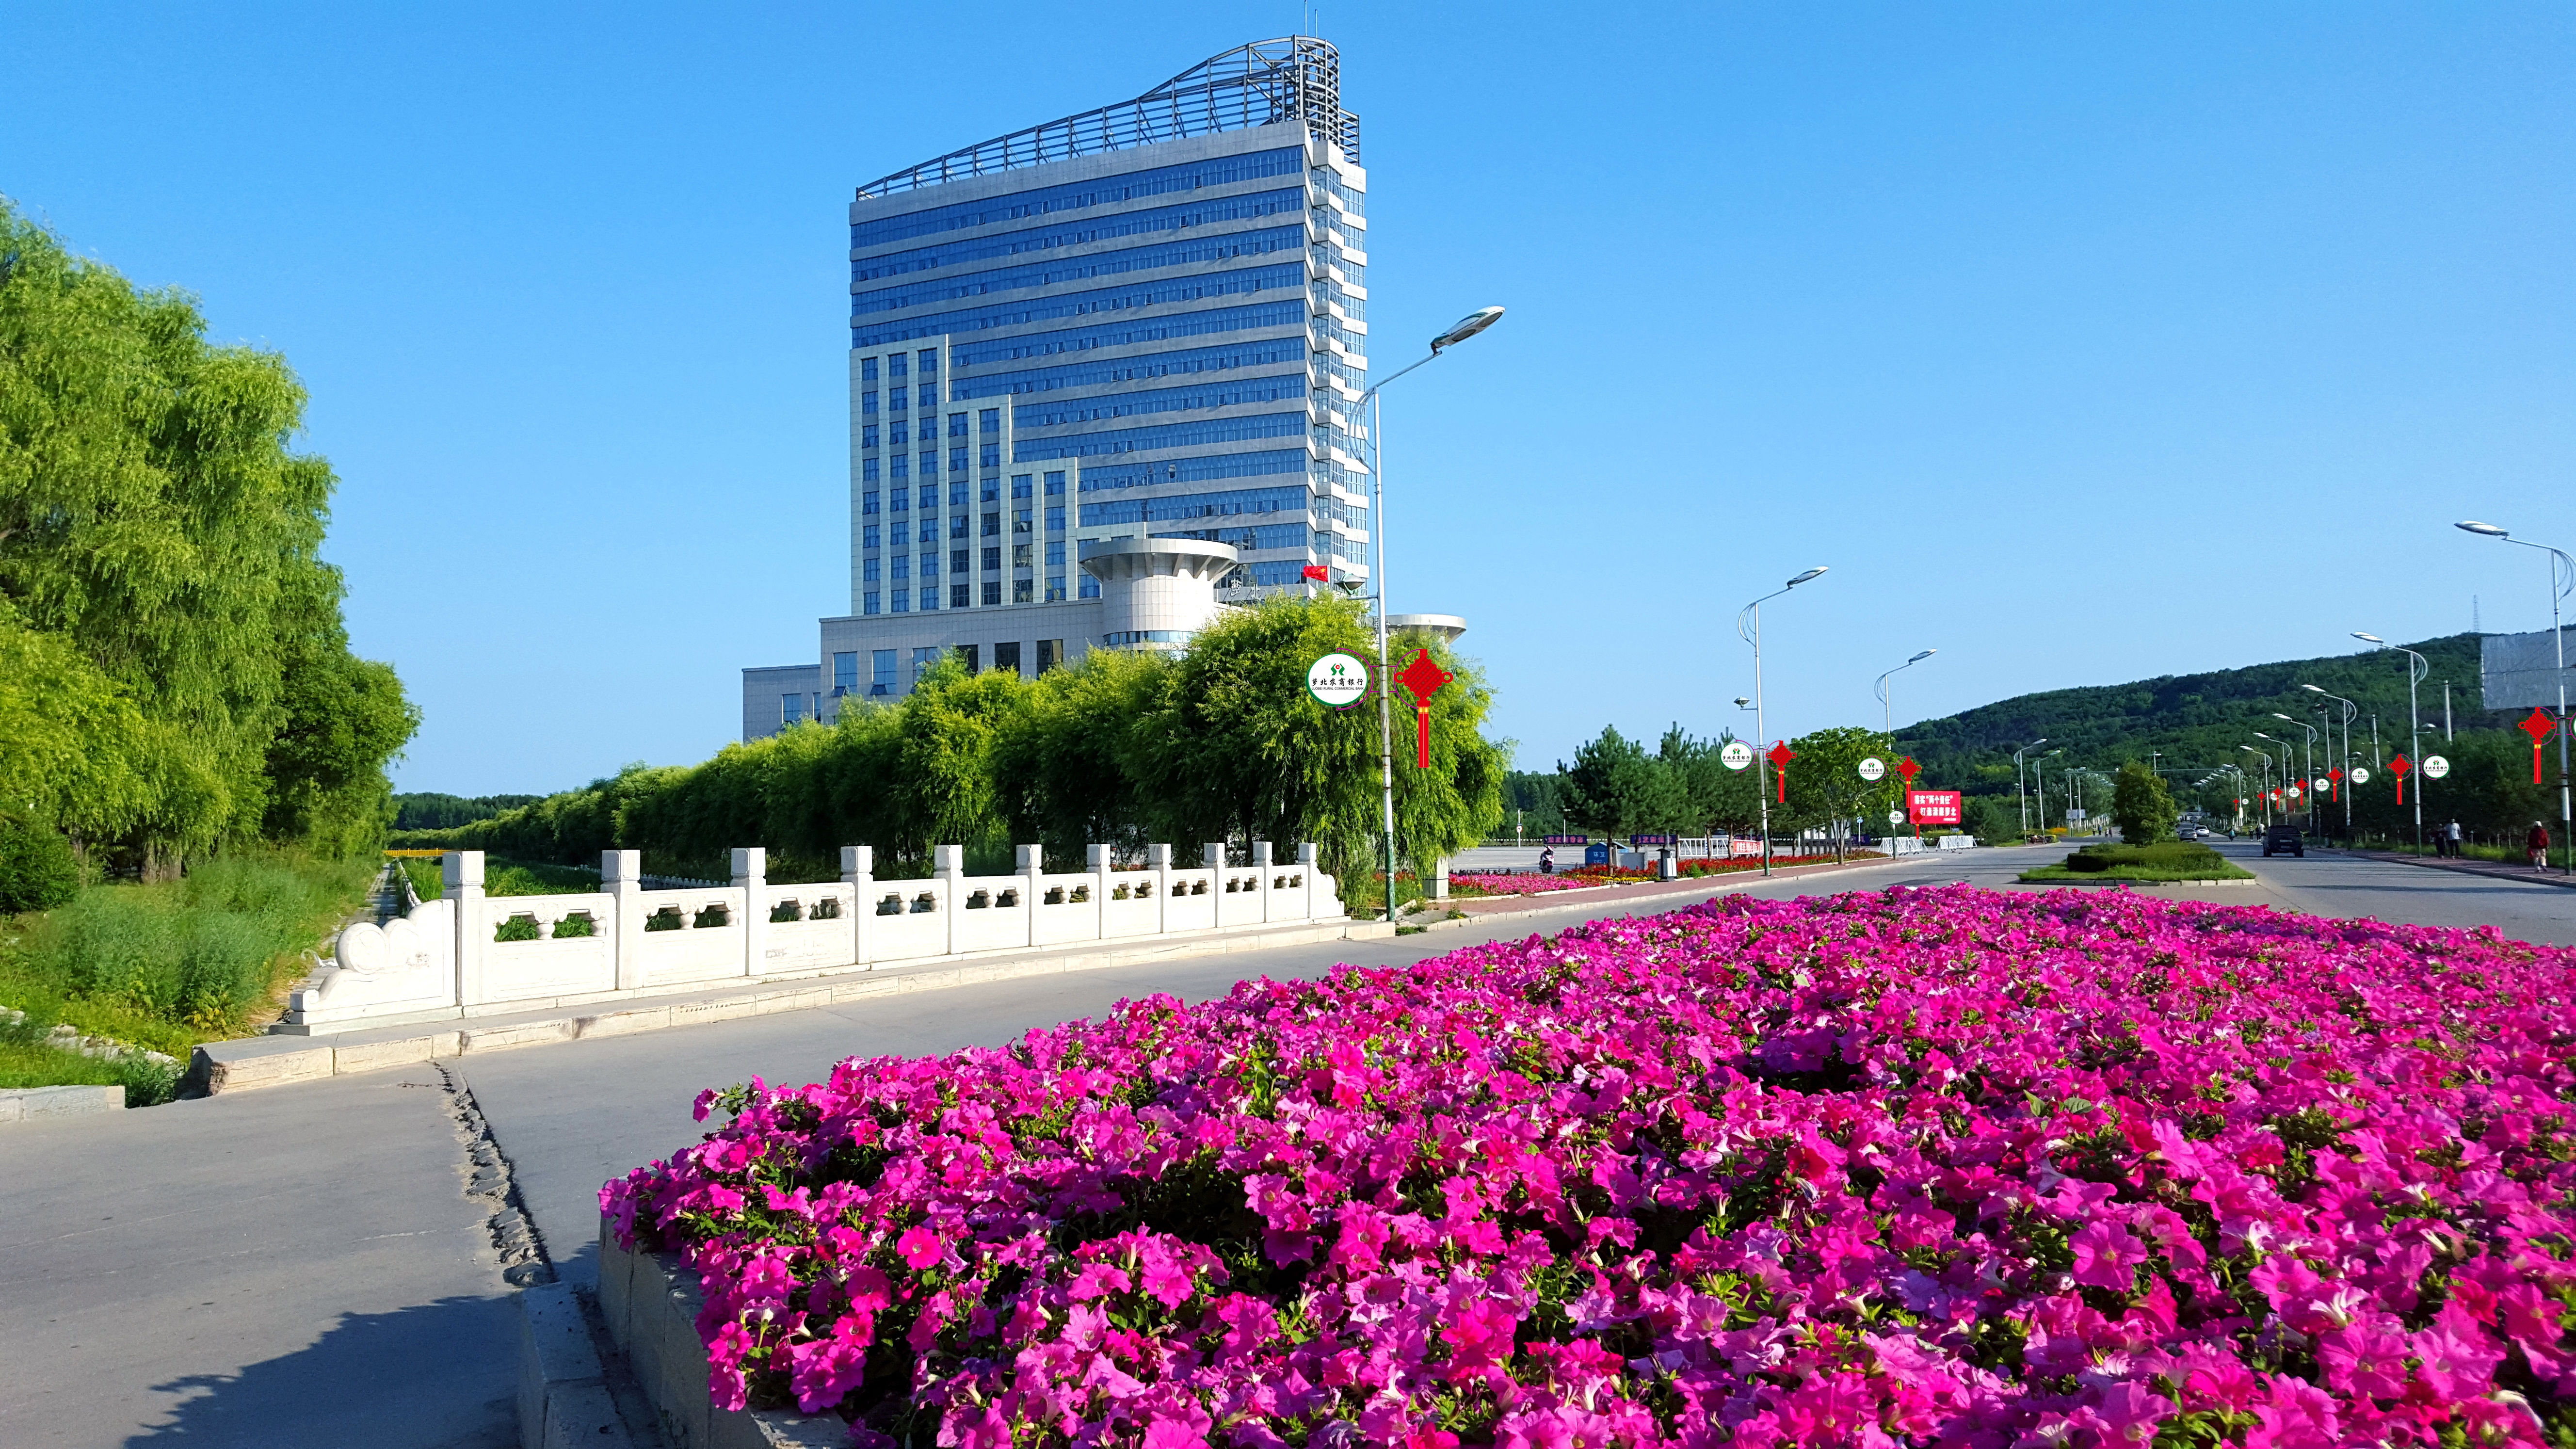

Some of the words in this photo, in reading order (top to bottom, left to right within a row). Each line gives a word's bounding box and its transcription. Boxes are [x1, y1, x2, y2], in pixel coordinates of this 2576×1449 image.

[1312, 677, 1363, 687] 萝北农商银行
